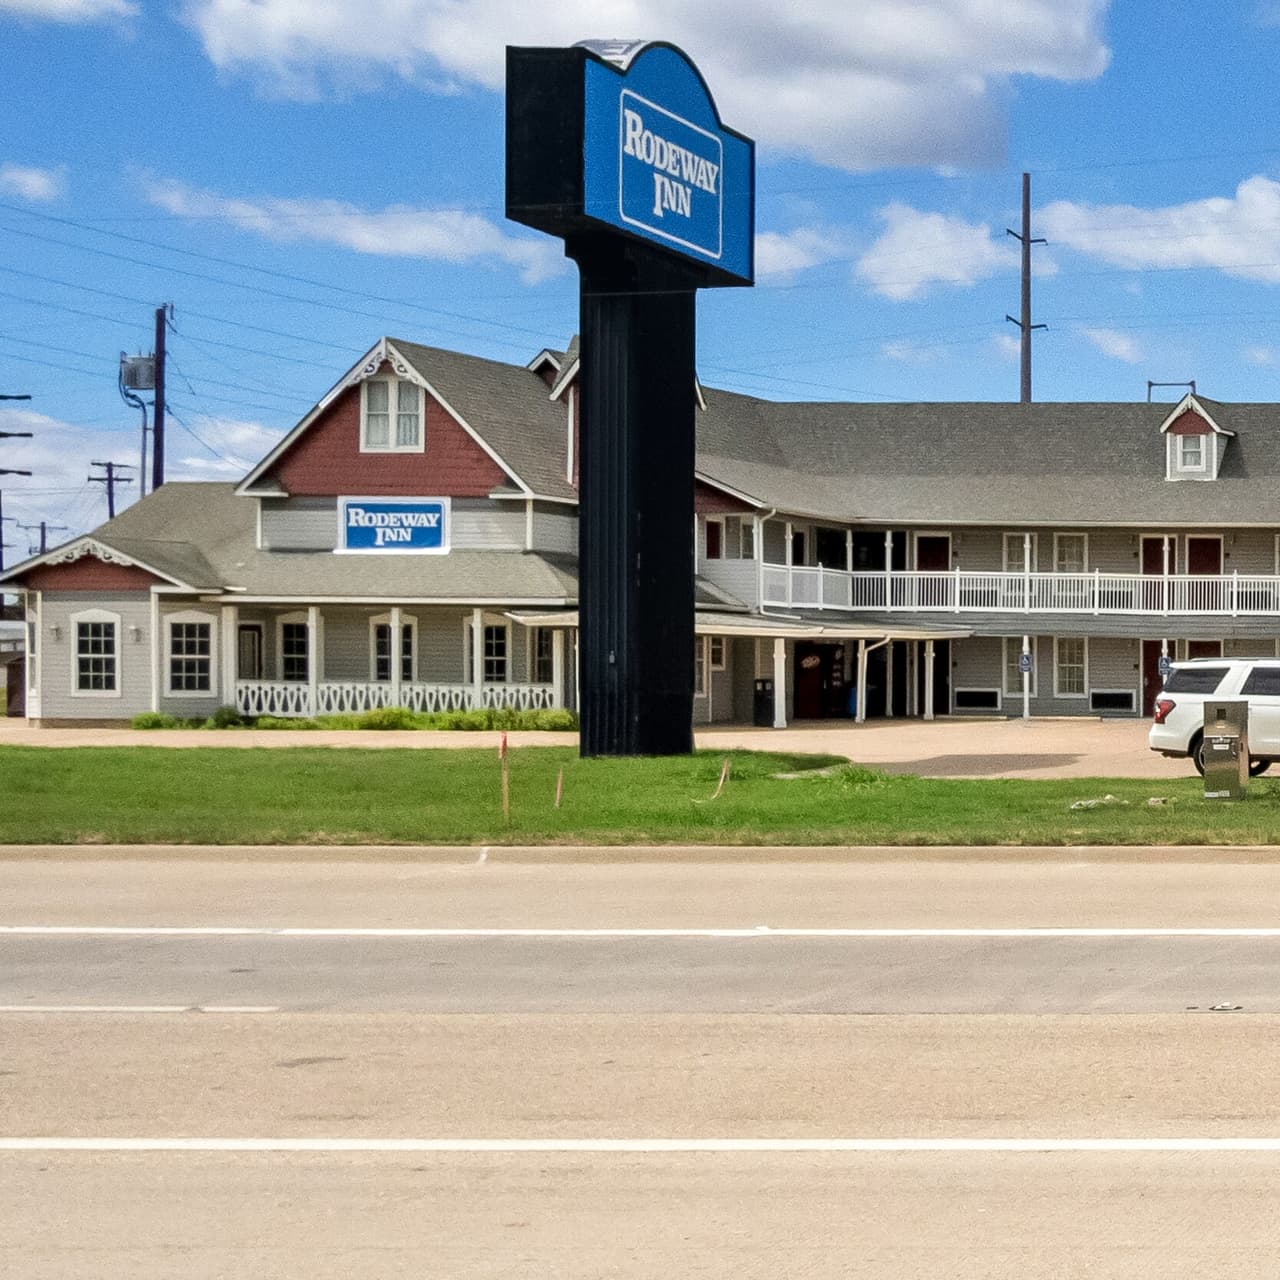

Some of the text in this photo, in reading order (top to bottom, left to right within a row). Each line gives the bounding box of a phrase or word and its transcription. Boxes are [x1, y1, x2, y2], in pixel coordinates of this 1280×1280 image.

[624, 108, 719, 195] RODEWAY
[653, 172, 692, 218] INN
[347, 508, 440, 527] RODEWAY
[374, 527, 412, 546] INN
